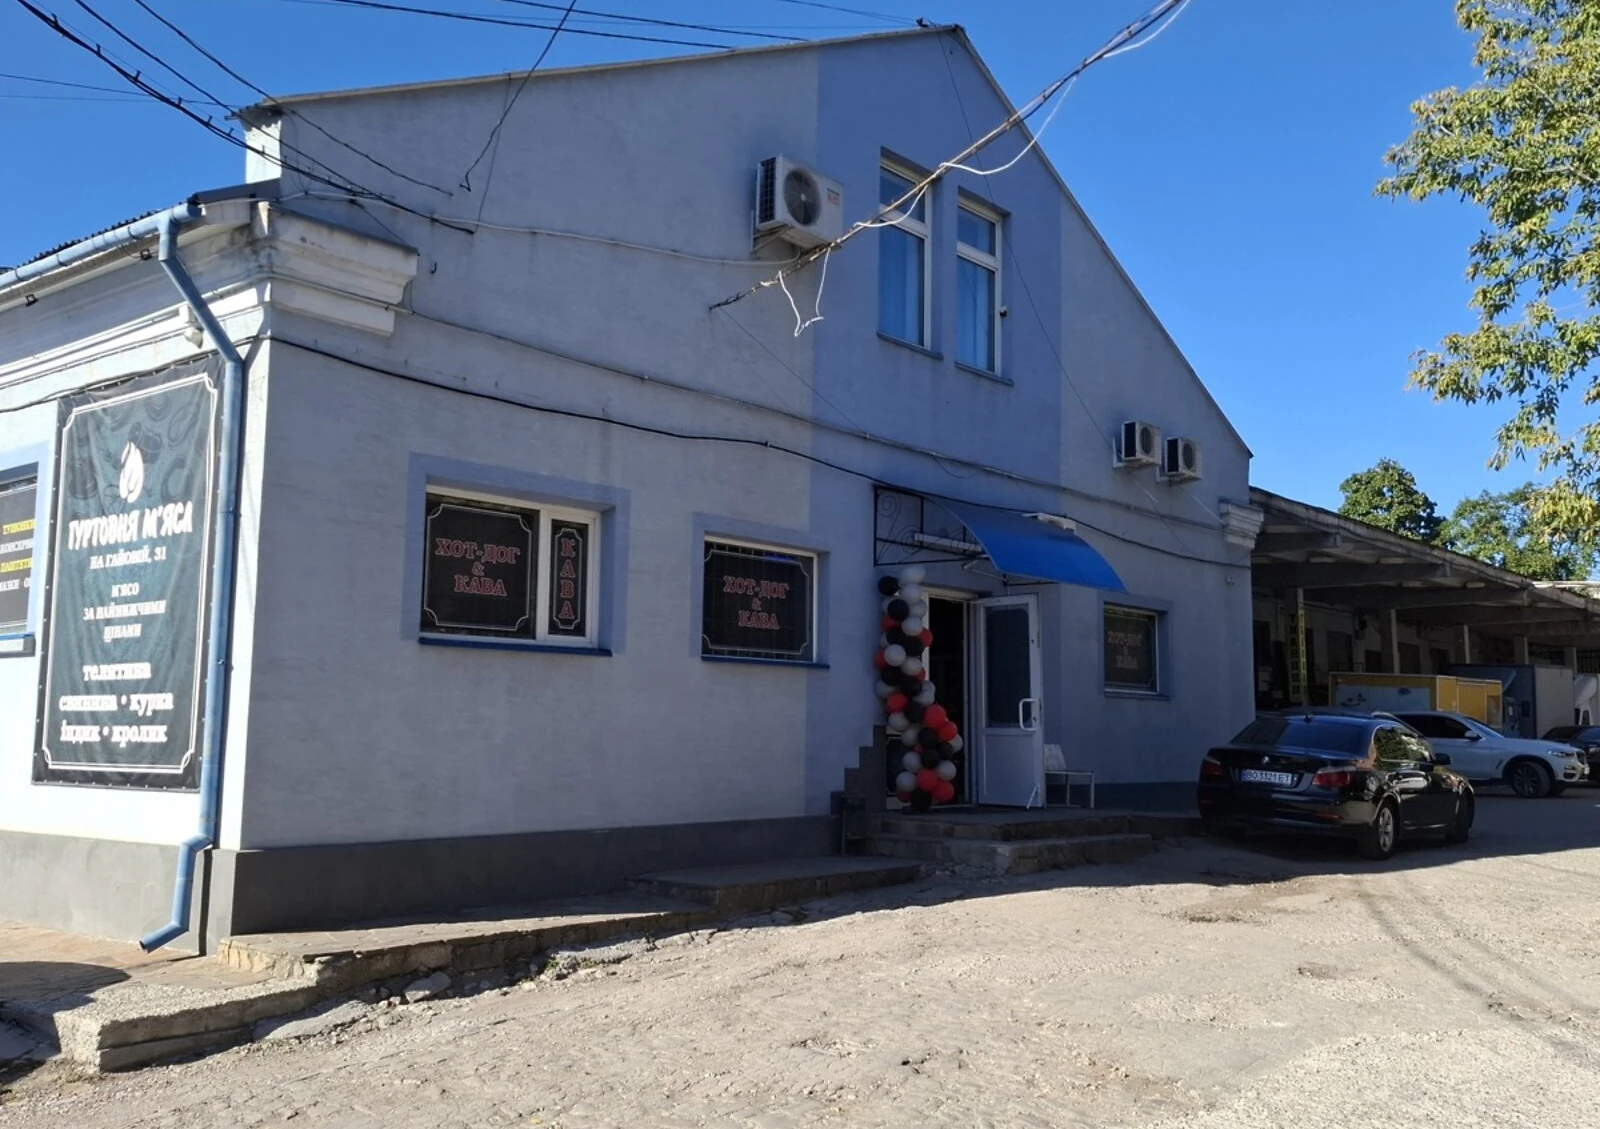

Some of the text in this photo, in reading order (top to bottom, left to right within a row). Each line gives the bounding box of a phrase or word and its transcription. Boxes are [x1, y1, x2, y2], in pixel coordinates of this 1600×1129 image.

[68, 500, 193, 550] ГУРТОВНЯ М'ЯСА
[434, 537, 521, 564] ХОТ-ДОГ
[90, 555, 105, 570] НА
[471, 561, 485, 576] &
[454, 574, 507, 597] КАВА
[558, 538, 576, 619] КАВА
[723, 575, 790, 599] ХОТ-ДОГ
[83, 607, 95, 621] ЗА
[738, 609, 780, 630] КАВА
